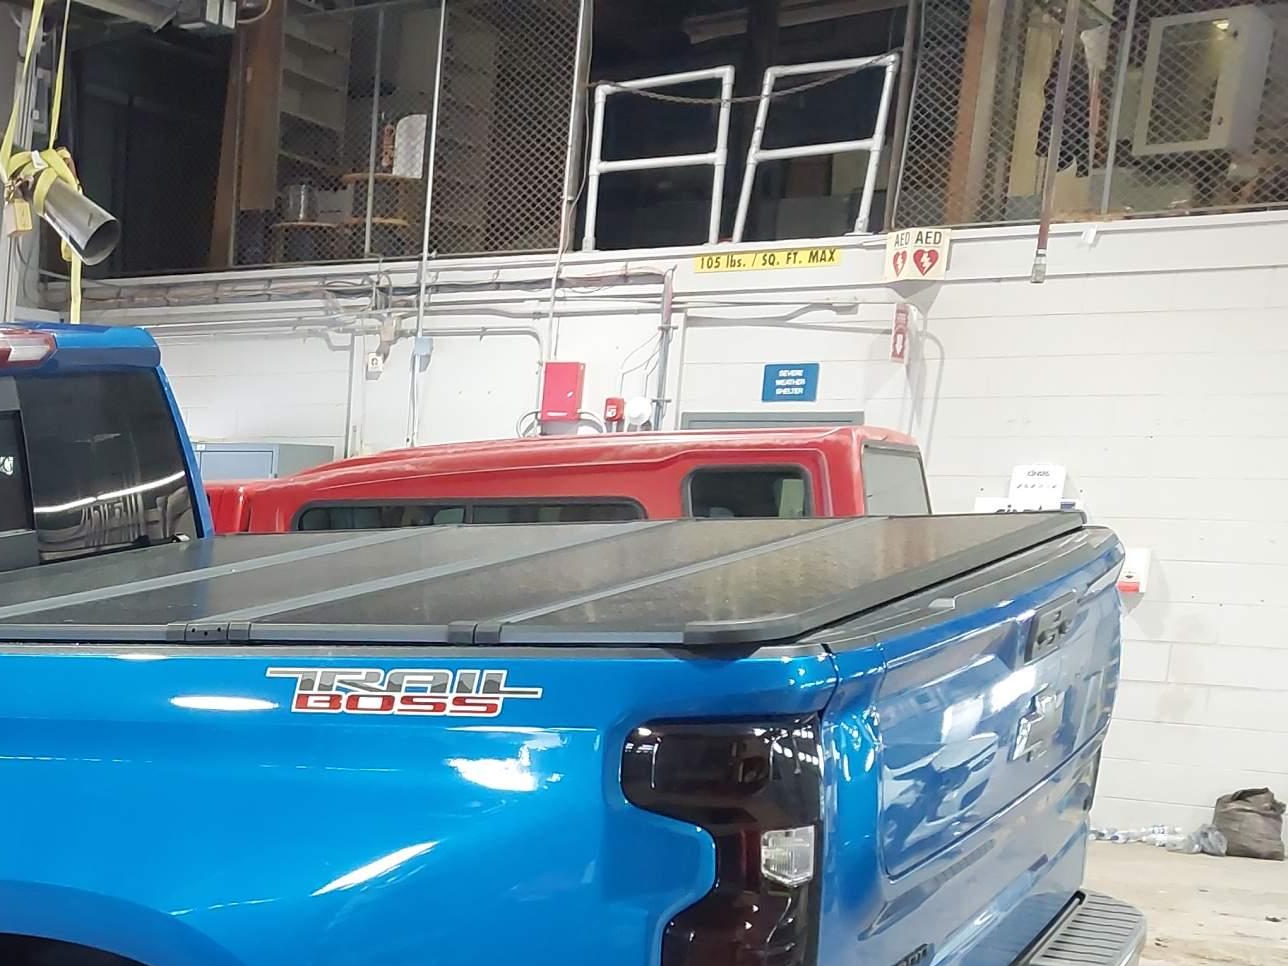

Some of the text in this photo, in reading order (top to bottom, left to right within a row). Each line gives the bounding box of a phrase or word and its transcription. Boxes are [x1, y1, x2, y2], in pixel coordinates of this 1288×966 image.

[894, 231, 911, 248] AED
[915, 230, 943, 245] AED
[700, 248, 837, 269] 105 lbs. / SQ. FT. MAX
[266, 667, 542, 698] TRAIL
[292, 691, 504, 717] BOSS
